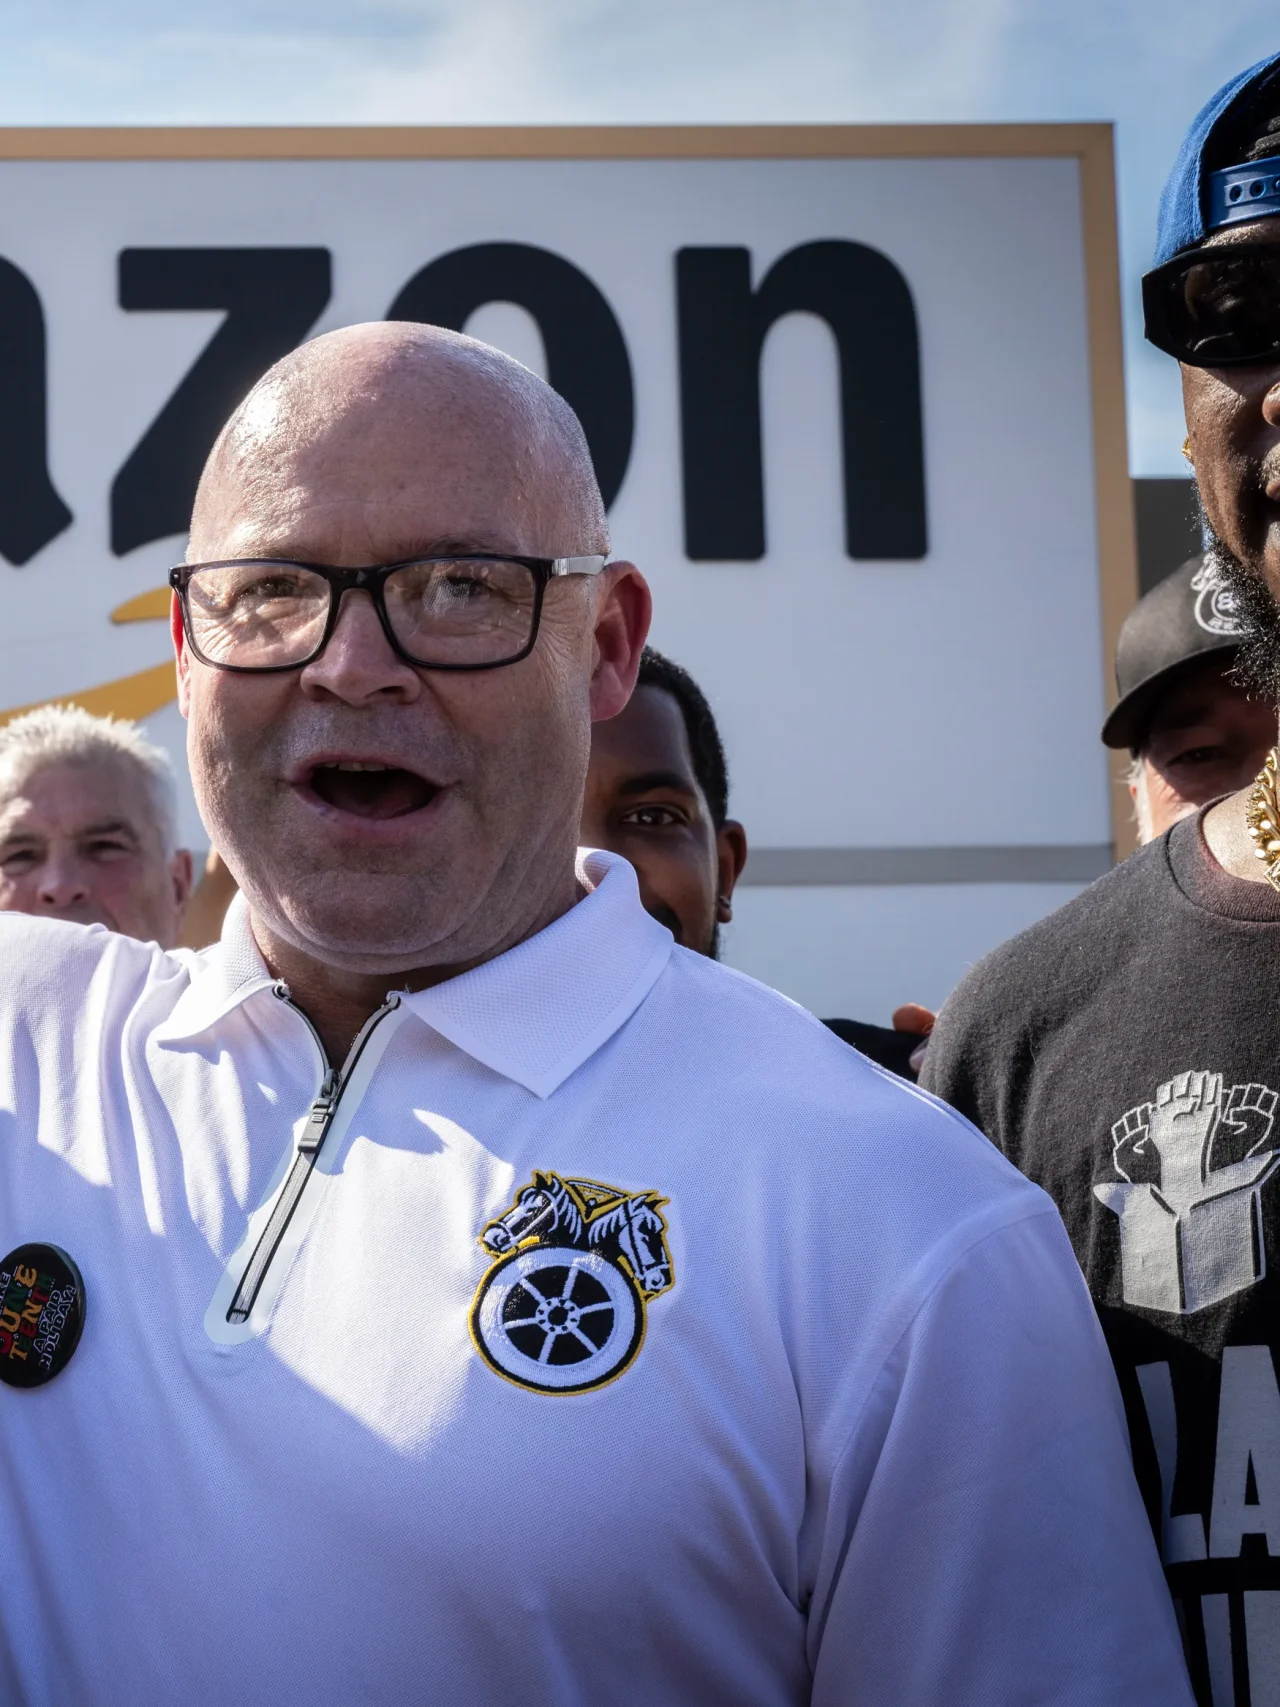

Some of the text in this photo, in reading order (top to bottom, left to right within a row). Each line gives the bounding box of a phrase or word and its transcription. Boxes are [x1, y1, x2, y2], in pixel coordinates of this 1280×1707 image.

[33, 1290, 61, 1353] A PAID
[39, 1285, 77, 1370] HOLIDAY!
